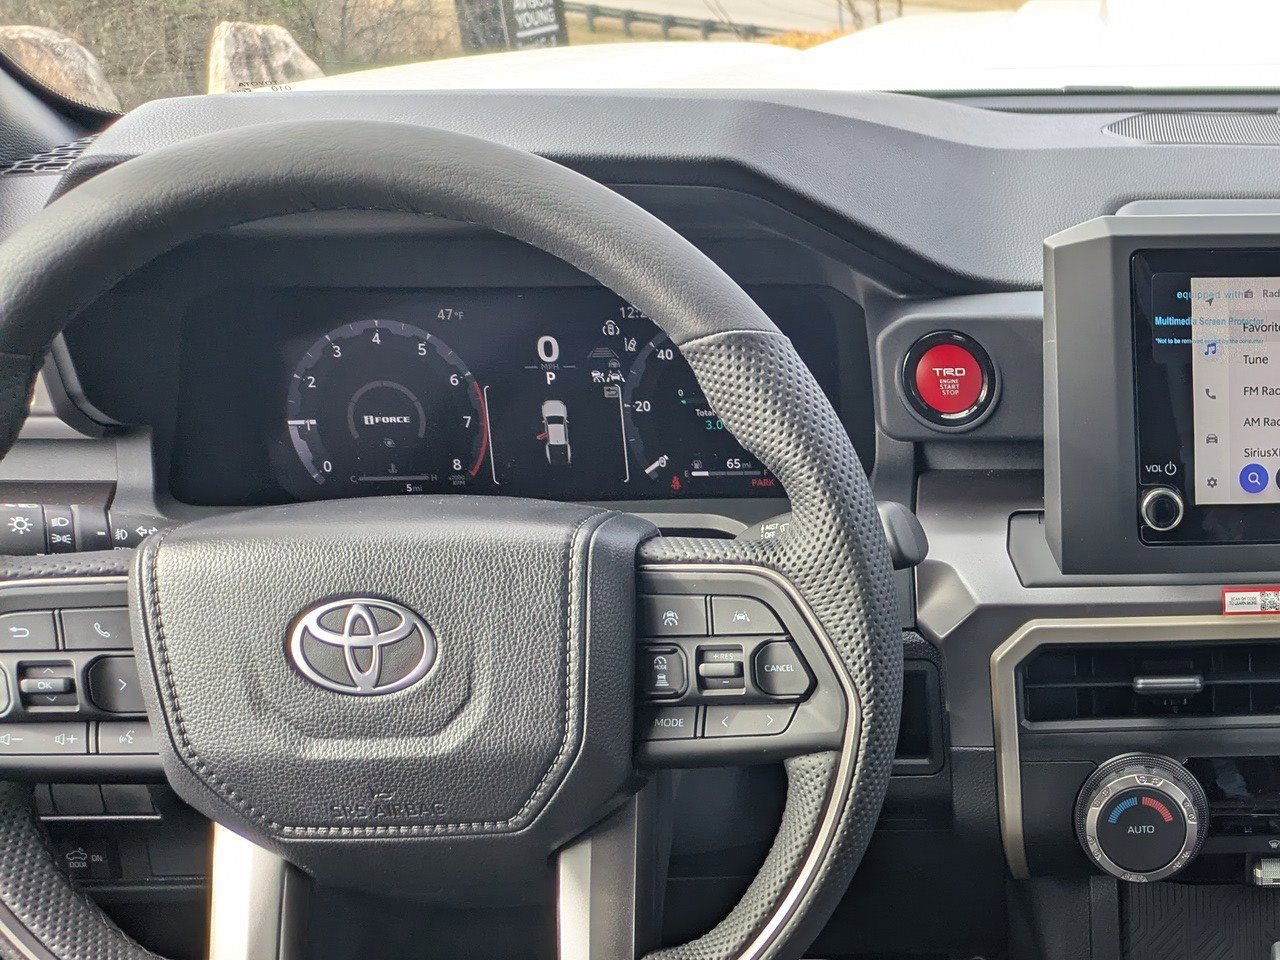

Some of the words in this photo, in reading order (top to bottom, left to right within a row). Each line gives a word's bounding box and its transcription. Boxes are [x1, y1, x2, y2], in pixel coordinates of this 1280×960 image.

[437, 309, 464, 320] 47°F
[372, 334, 381, 344] 4
[333, 346, 342, 358] 3
[418, 344, 426, 356] 5
[537, 336, 560, 362] 0
[657, 349, 673, 360] 40
[1243, 354, 1268, 364] Tune
[546, 372, 556, 384] P
[932, 368, 966, 377] TRD
[307, 377, 316, 388] 2
[450, 374, 459, 386] 6
[1243, 386, 1258, 396] FM
[636, 401, 650, 411] 20
[463, 416, 472, 428] 7
[1243, 418, 1260, 426] AM
[323, 461, 332, 472] 0
[452, 459, 462, 470] 8
[764, 664, 794, 672] CANCEL
[37, 681, 52, 690] OK
[1127, 826, 1155, 834] AUTO
